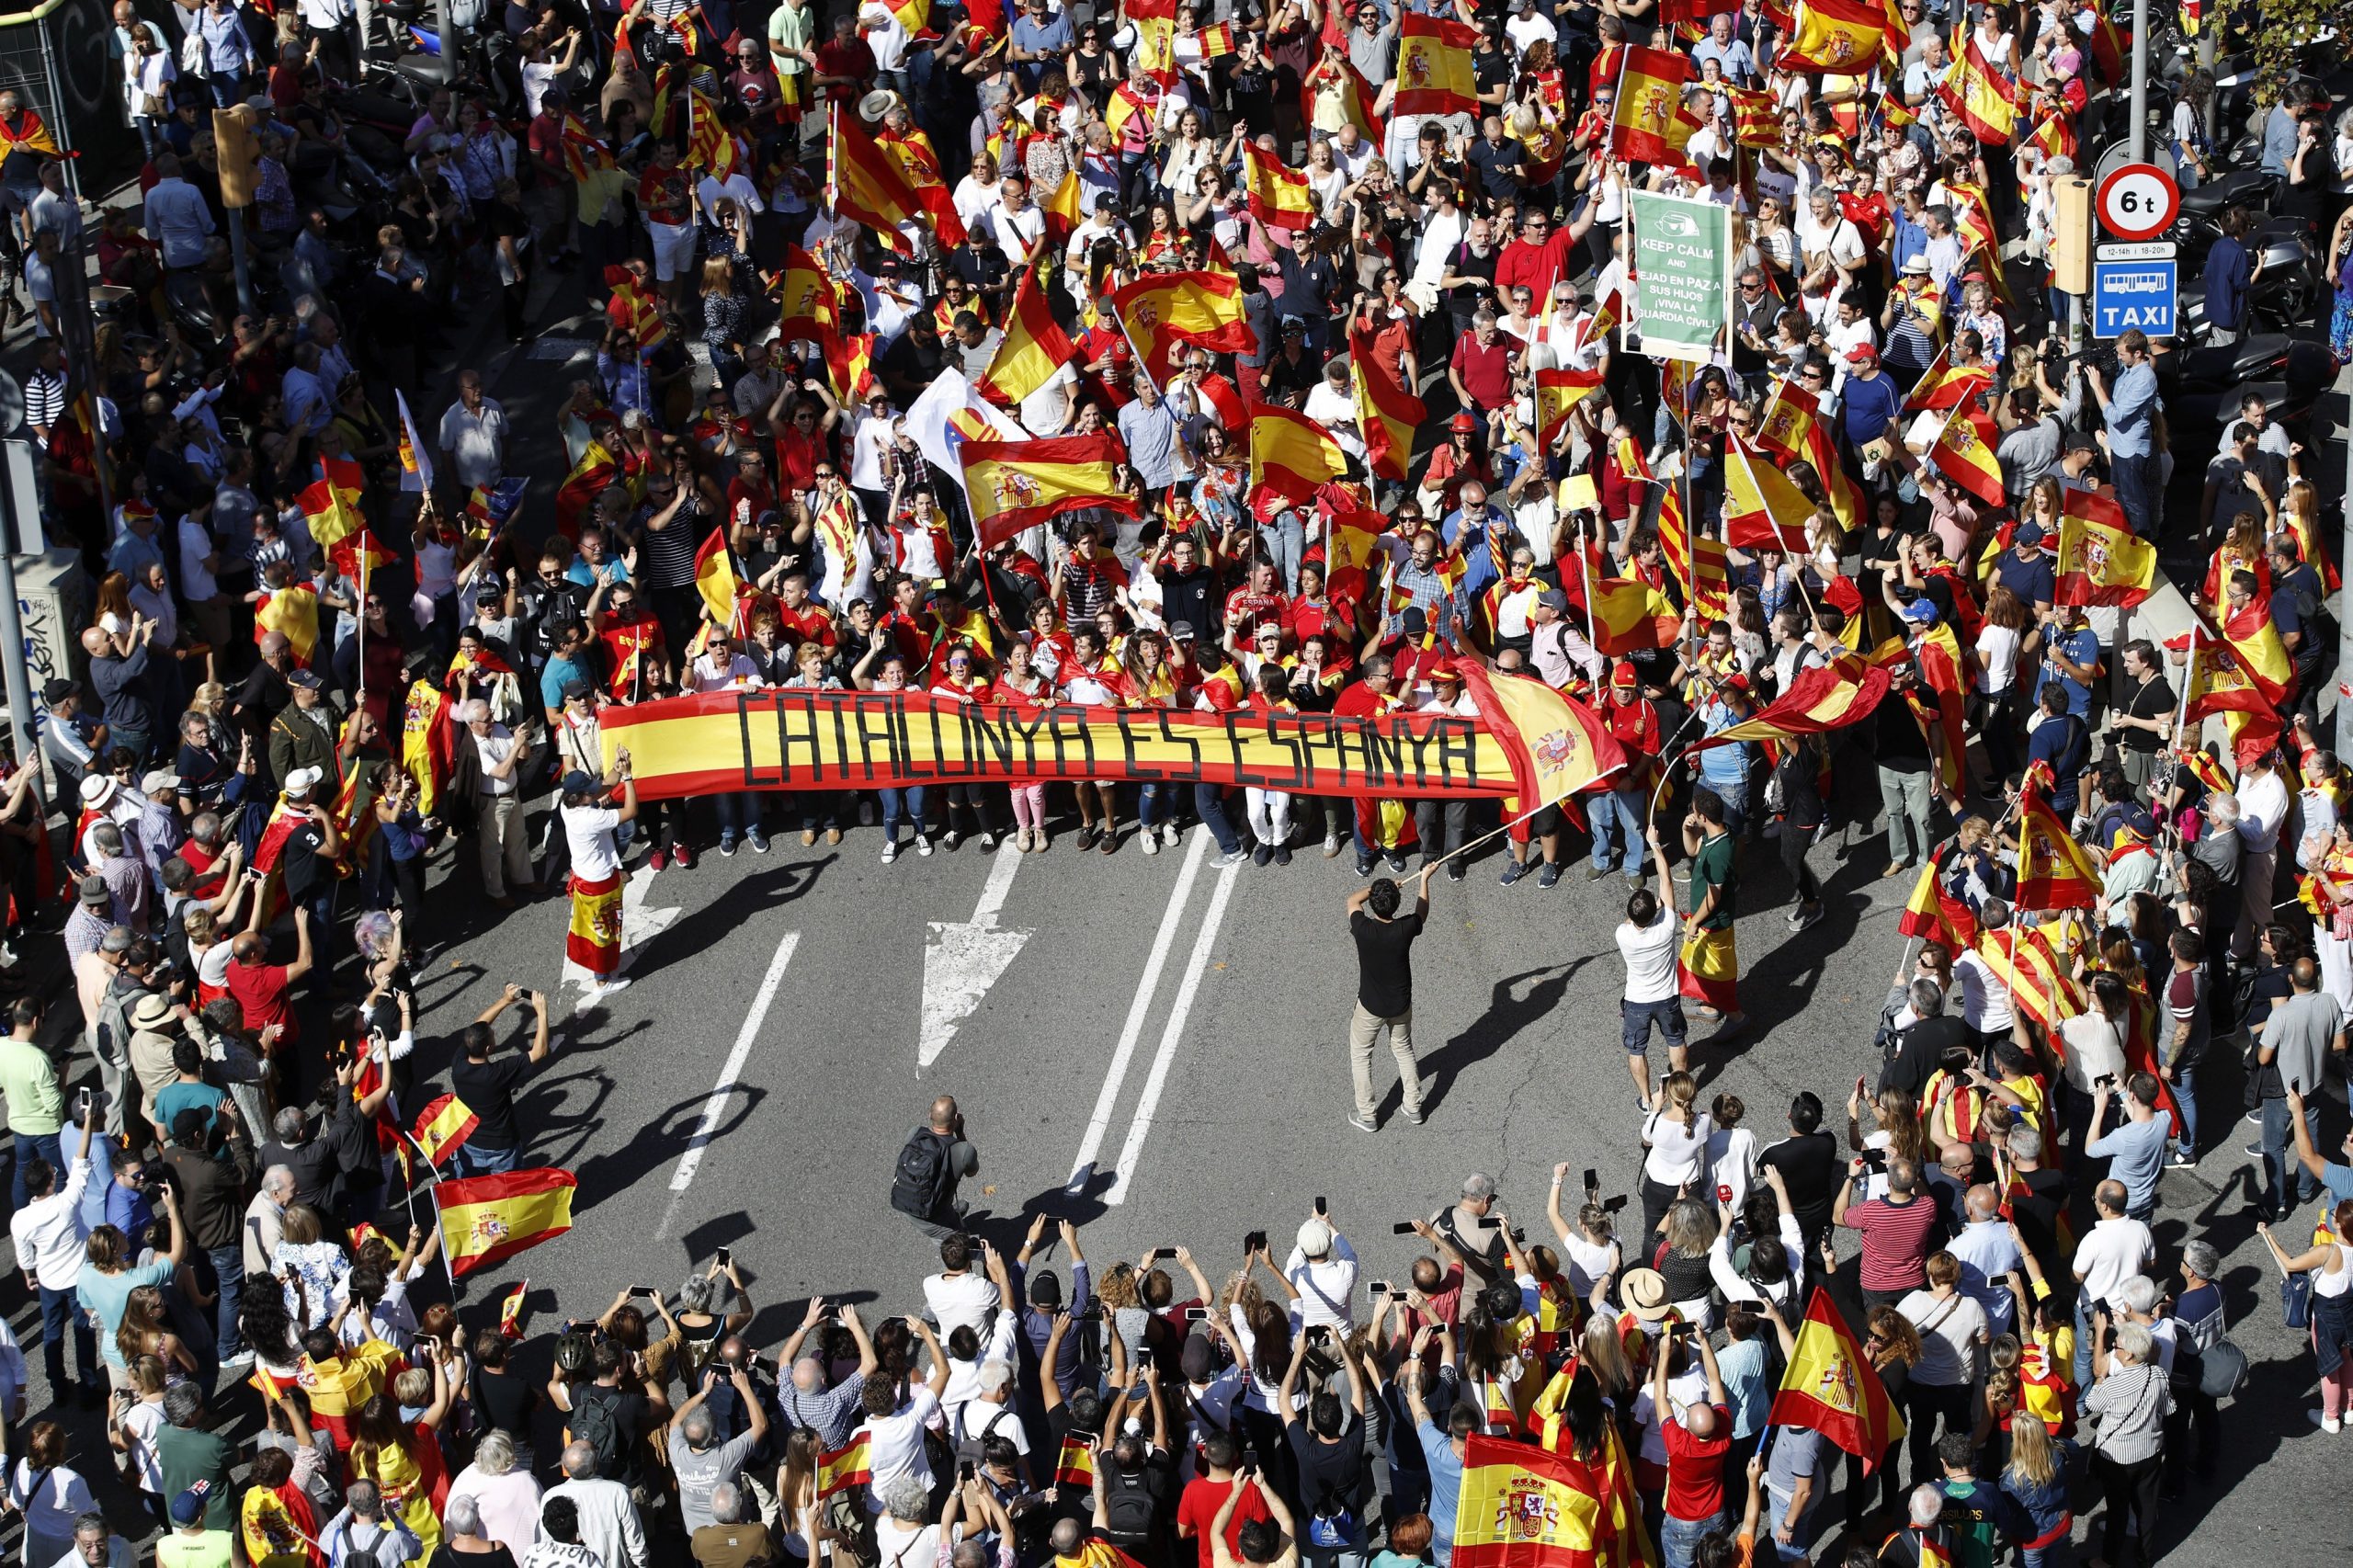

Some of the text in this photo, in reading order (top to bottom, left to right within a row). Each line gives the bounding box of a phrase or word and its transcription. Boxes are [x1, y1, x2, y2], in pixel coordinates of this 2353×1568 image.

[2120, 190, 2154, 213] 6 t
[1641, 238, 1713, 259] KEEP CALM
[2108, 248, 2131, 256] 12-14h
[2141, 246, 2165, 256] 18-20h
[1667, 258, 1687, 268] AND
[1670, 276, 1684, 286] EN
[1687, 277, 1711, 291] PAZ
[1713, 281, 1722, 290] A
[1649, 285, 1703, 302] SUS HIJOS
[1654, 299, 1697, 313] ¡VIVA LA
[1687, 315, 1715, 328] CIVIL!
[2103, 306, 2167, 326] TAXI
[618, 634, 654, 649] ESAÑ
[737, 693, 1477, 789] CATALUNYA ES ESPANYA
[306, 833, 320, 846] 3
